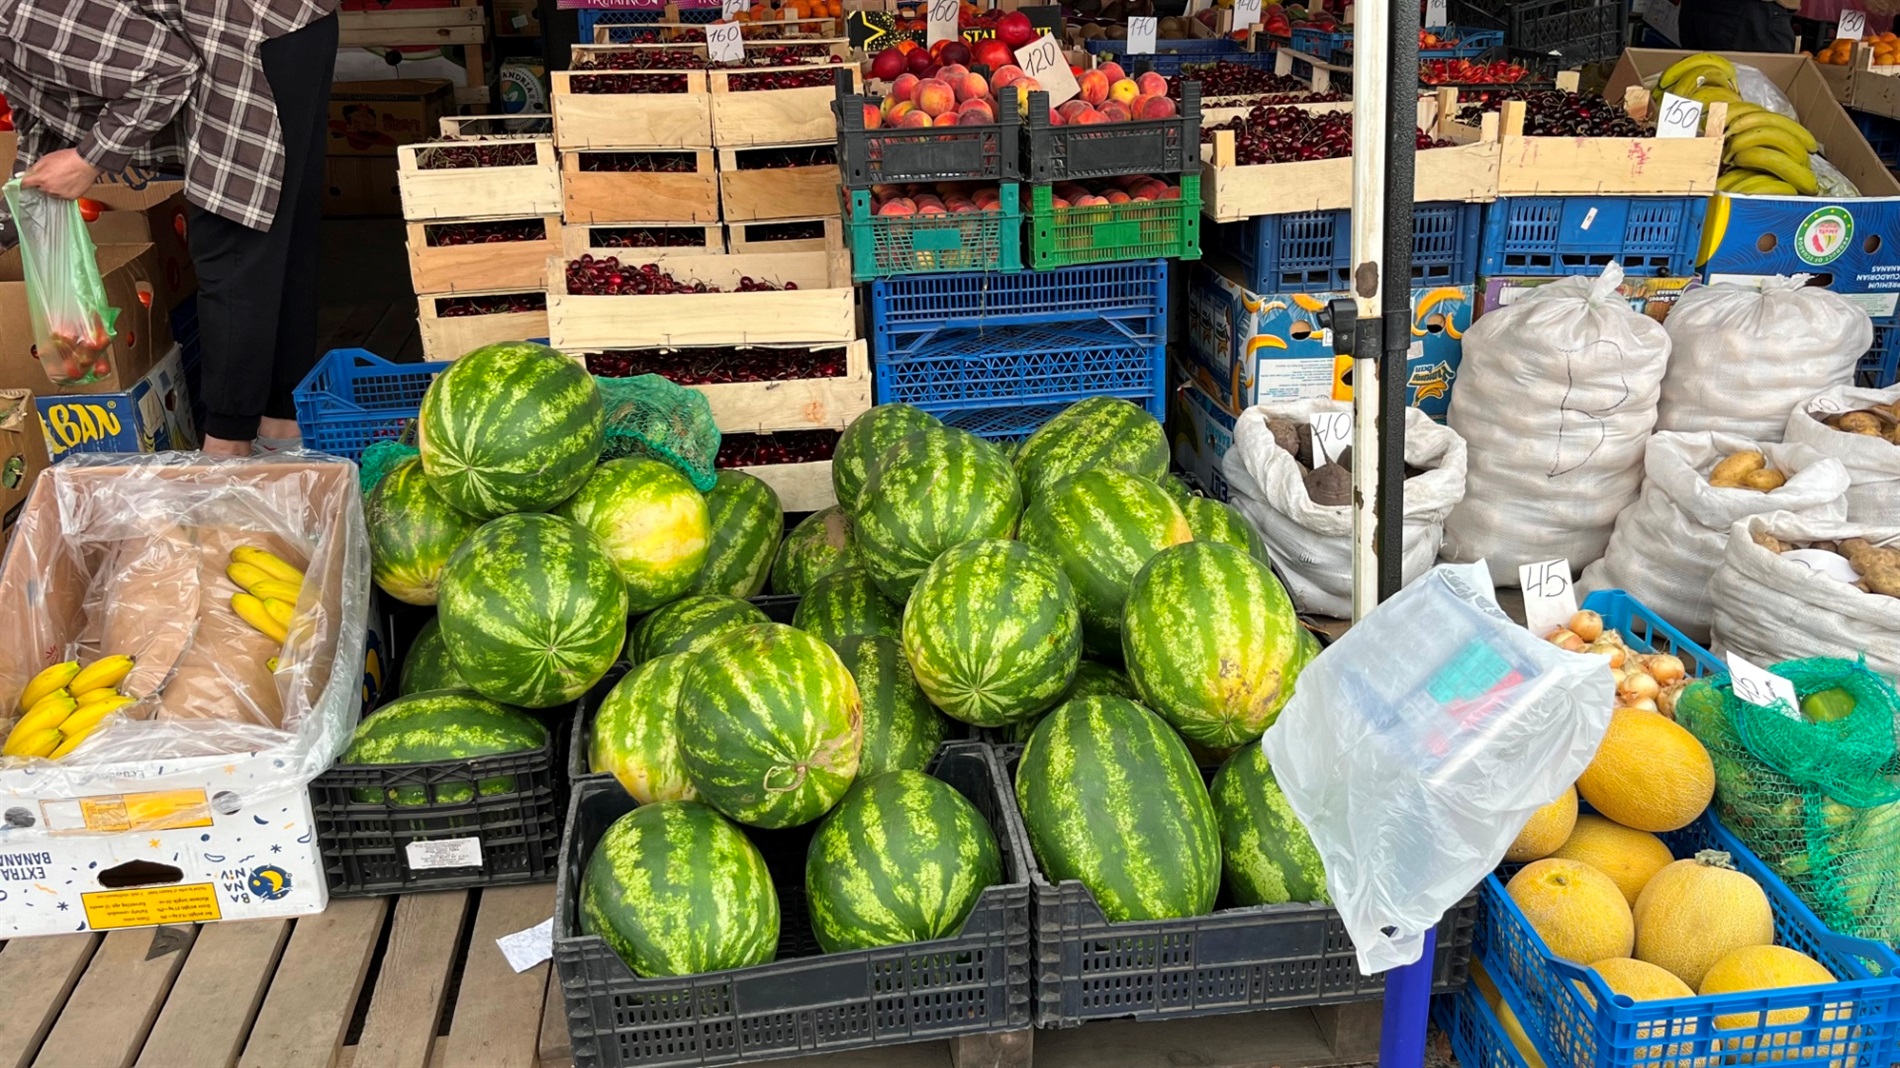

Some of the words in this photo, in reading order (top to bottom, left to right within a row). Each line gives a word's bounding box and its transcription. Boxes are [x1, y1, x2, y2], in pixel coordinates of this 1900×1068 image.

[1130, 17, 1155, 36] 170
[1840, 12, 1864, 32] 130
[709, 26, 739, 42] 160
[1025, 41, 1055, 76] 120
[1663, 99, 1700, 129] 150
[1856, 273, 1900, 281] CUADORIAN
[1526, 559, 1568, 598] 45
[0, 866, 46, 881] EXTRA
[223, 880, 245, 892] NA
[230, 892, 251, 904] BA
